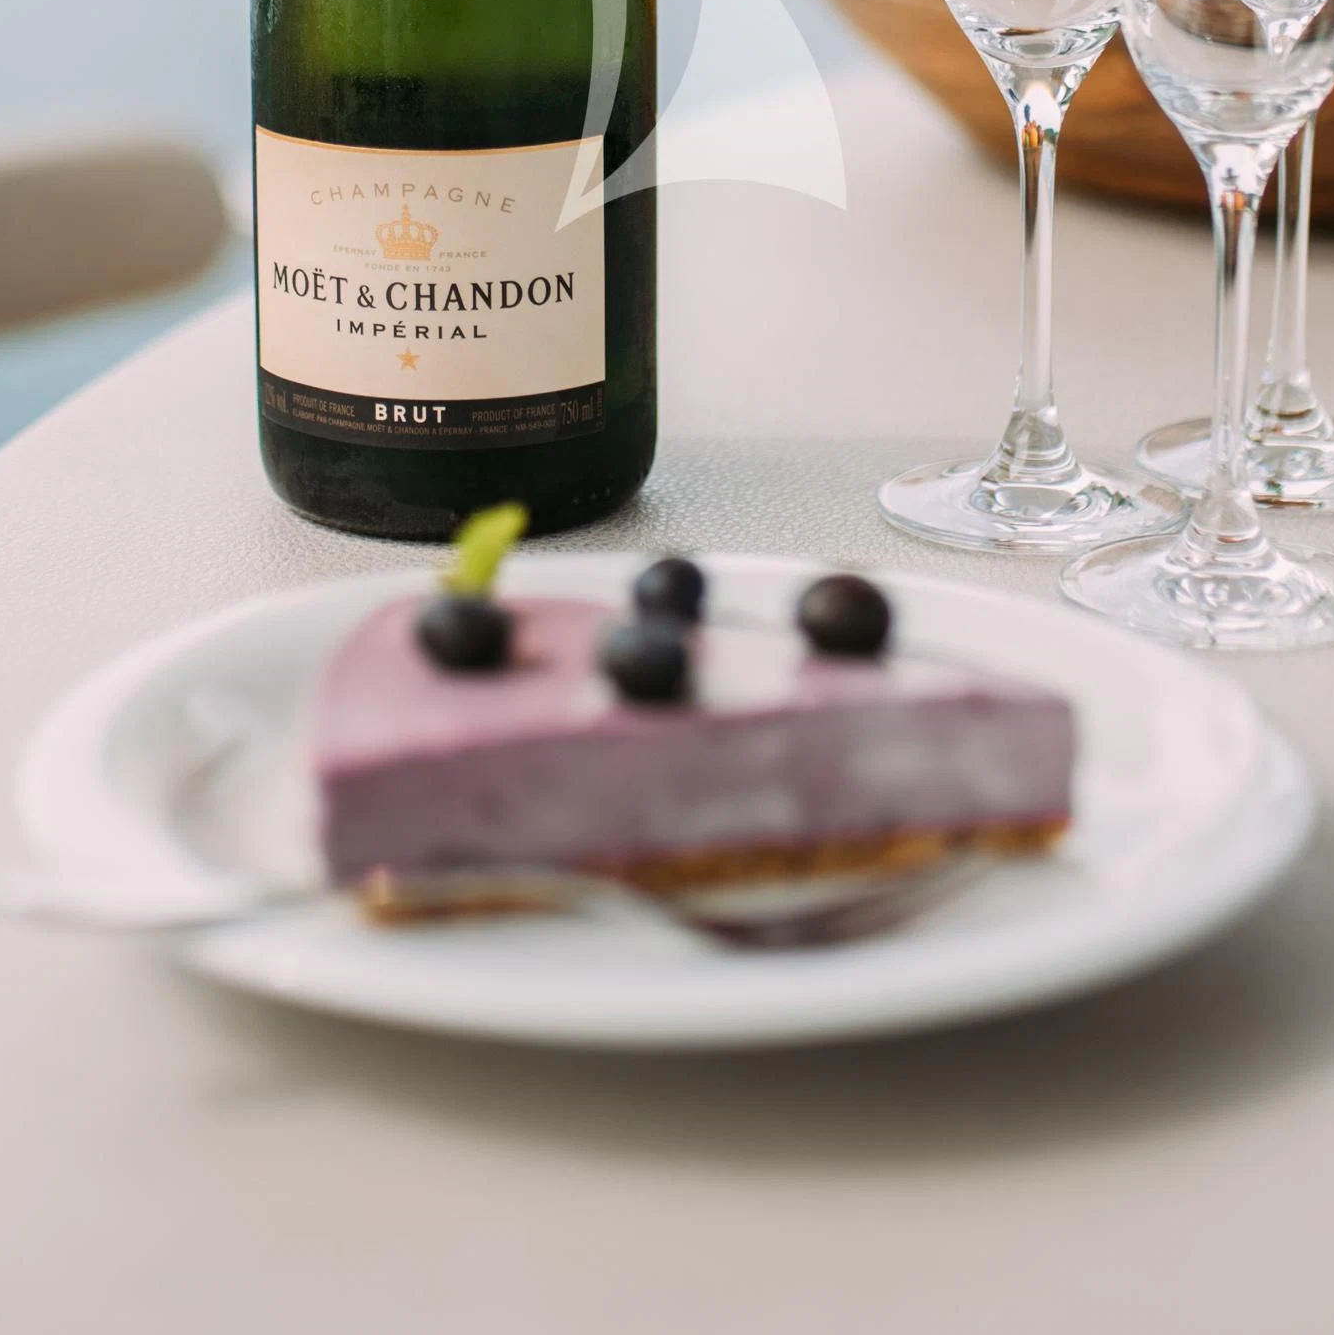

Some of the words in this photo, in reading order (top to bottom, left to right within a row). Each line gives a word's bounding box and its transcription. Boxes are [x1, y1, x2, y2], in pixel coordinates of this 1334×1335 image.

[310, 183, 516, 214] CHAMPAGNE
[439, 250, 487, 259] FRANCE
[405, 264, 420, 273] EN
[273, 262, 349, 305] MOËT
[357, 284, 377, 310] &
[385, 271, 576, 313] CHANDON
[336, 318, 488, 340] IMPÉRIAL
[329, 401, 356, 418] FRANCE
[374, 403, 447, 424] BRUT
[472, 409, 511, 422] PRODUCT
[513, 408, 524, 420] OF
[526, 403, 555, 417] FRANCE
[560, 398, 579, 425] 750
[581, 394, 594, 422] ml
[394, 425, 430, 435] CHANDON
[479, 424, 507, 434] FRANCE
